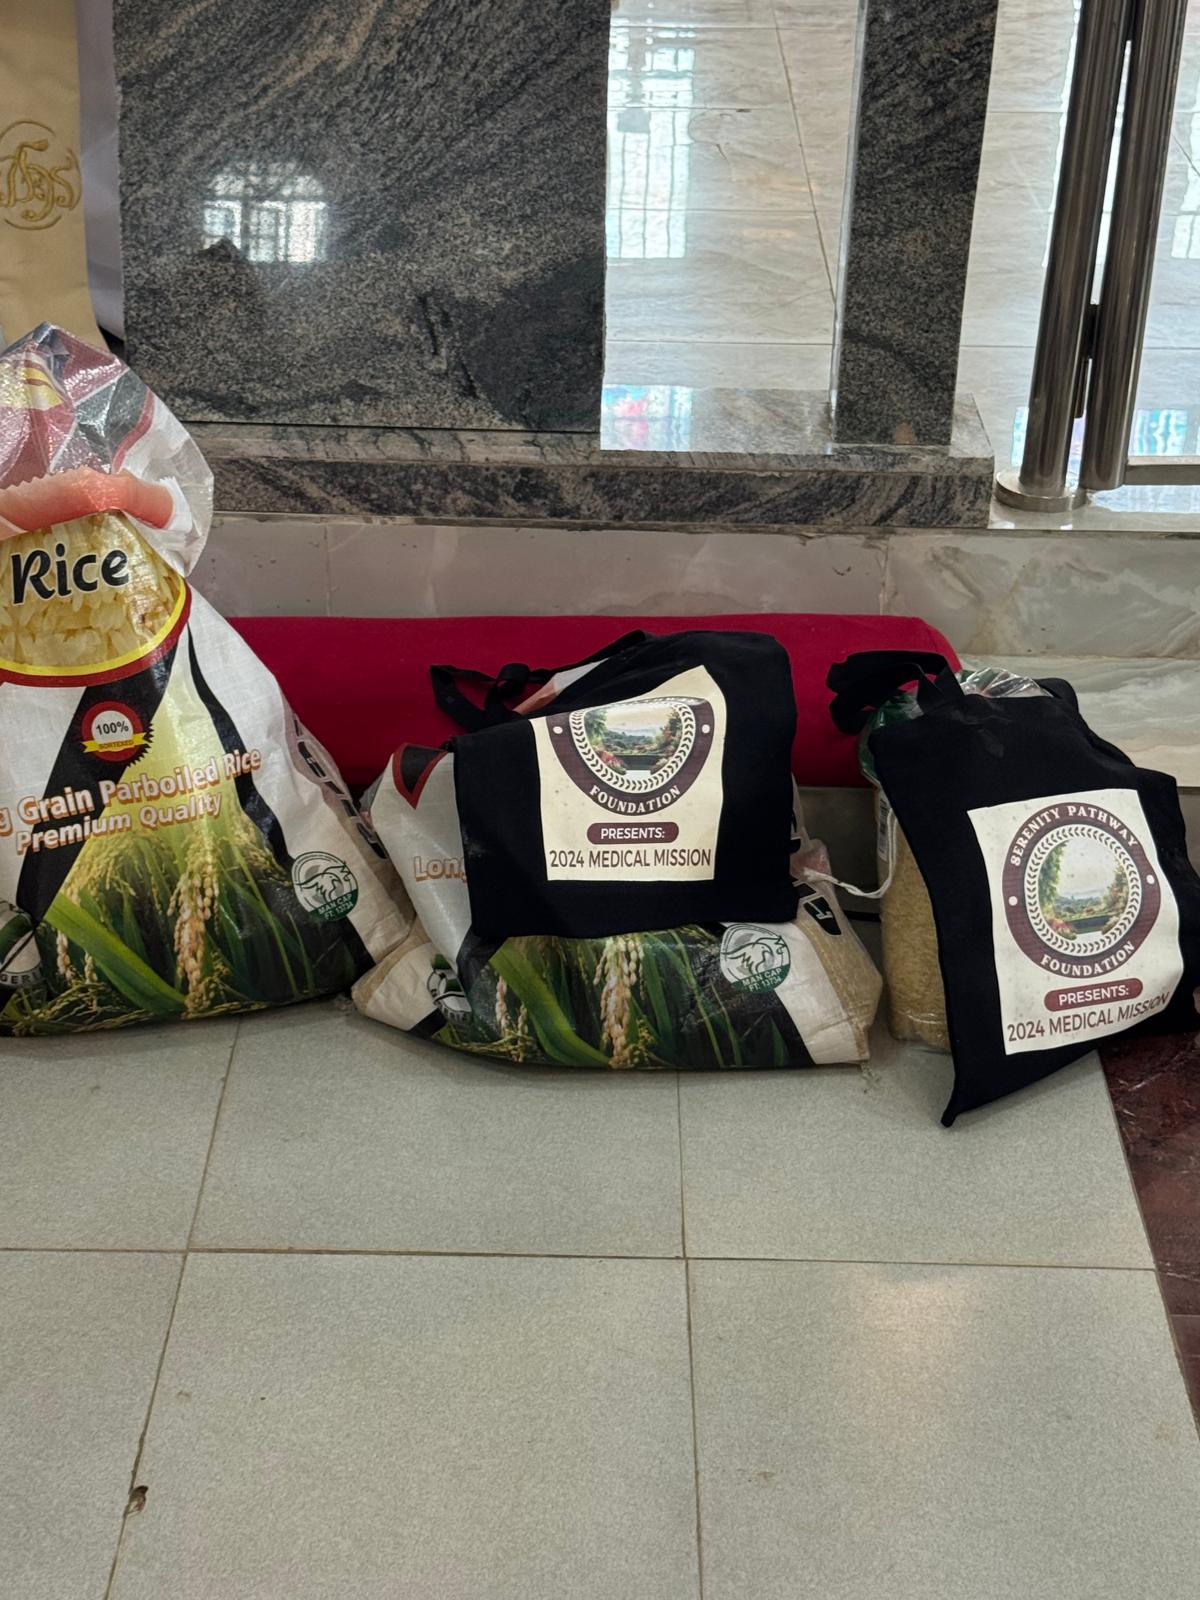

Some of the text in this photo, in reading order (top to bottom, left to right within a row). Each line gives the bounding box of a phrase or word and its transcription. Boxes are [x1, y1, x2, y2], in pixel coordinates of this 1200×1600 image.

[11, 543, 129, 604] Rice
[96, 720, 129, 735] 100%
[17, 787, 95, 825] Grain
[98, 761, 219, 804] Parboiled
[222, 748, 262, 778] Rice
[589, 785, 681, 813] FOUNDATION
[15, 815, 133, 855] Premium
[139, 791, 222, 828] Quality
[601, 827, 666, 840] PRESENTS:
[1010, 805, 1138, 867] SERENITY PATHWAY
[414, 855, 467, 882] Lon
[550, 848, 711, 868] 2024 MEDICAL MISSION
[1040, 940, 1135, 977] FOUNDATION
[742, 968, 782, 986] MAN CAP
[1058, 984, 1129, 1006] PRESENTS:
[1007, 992, 1170, 1042] 2024 MEDICAL MISSION
